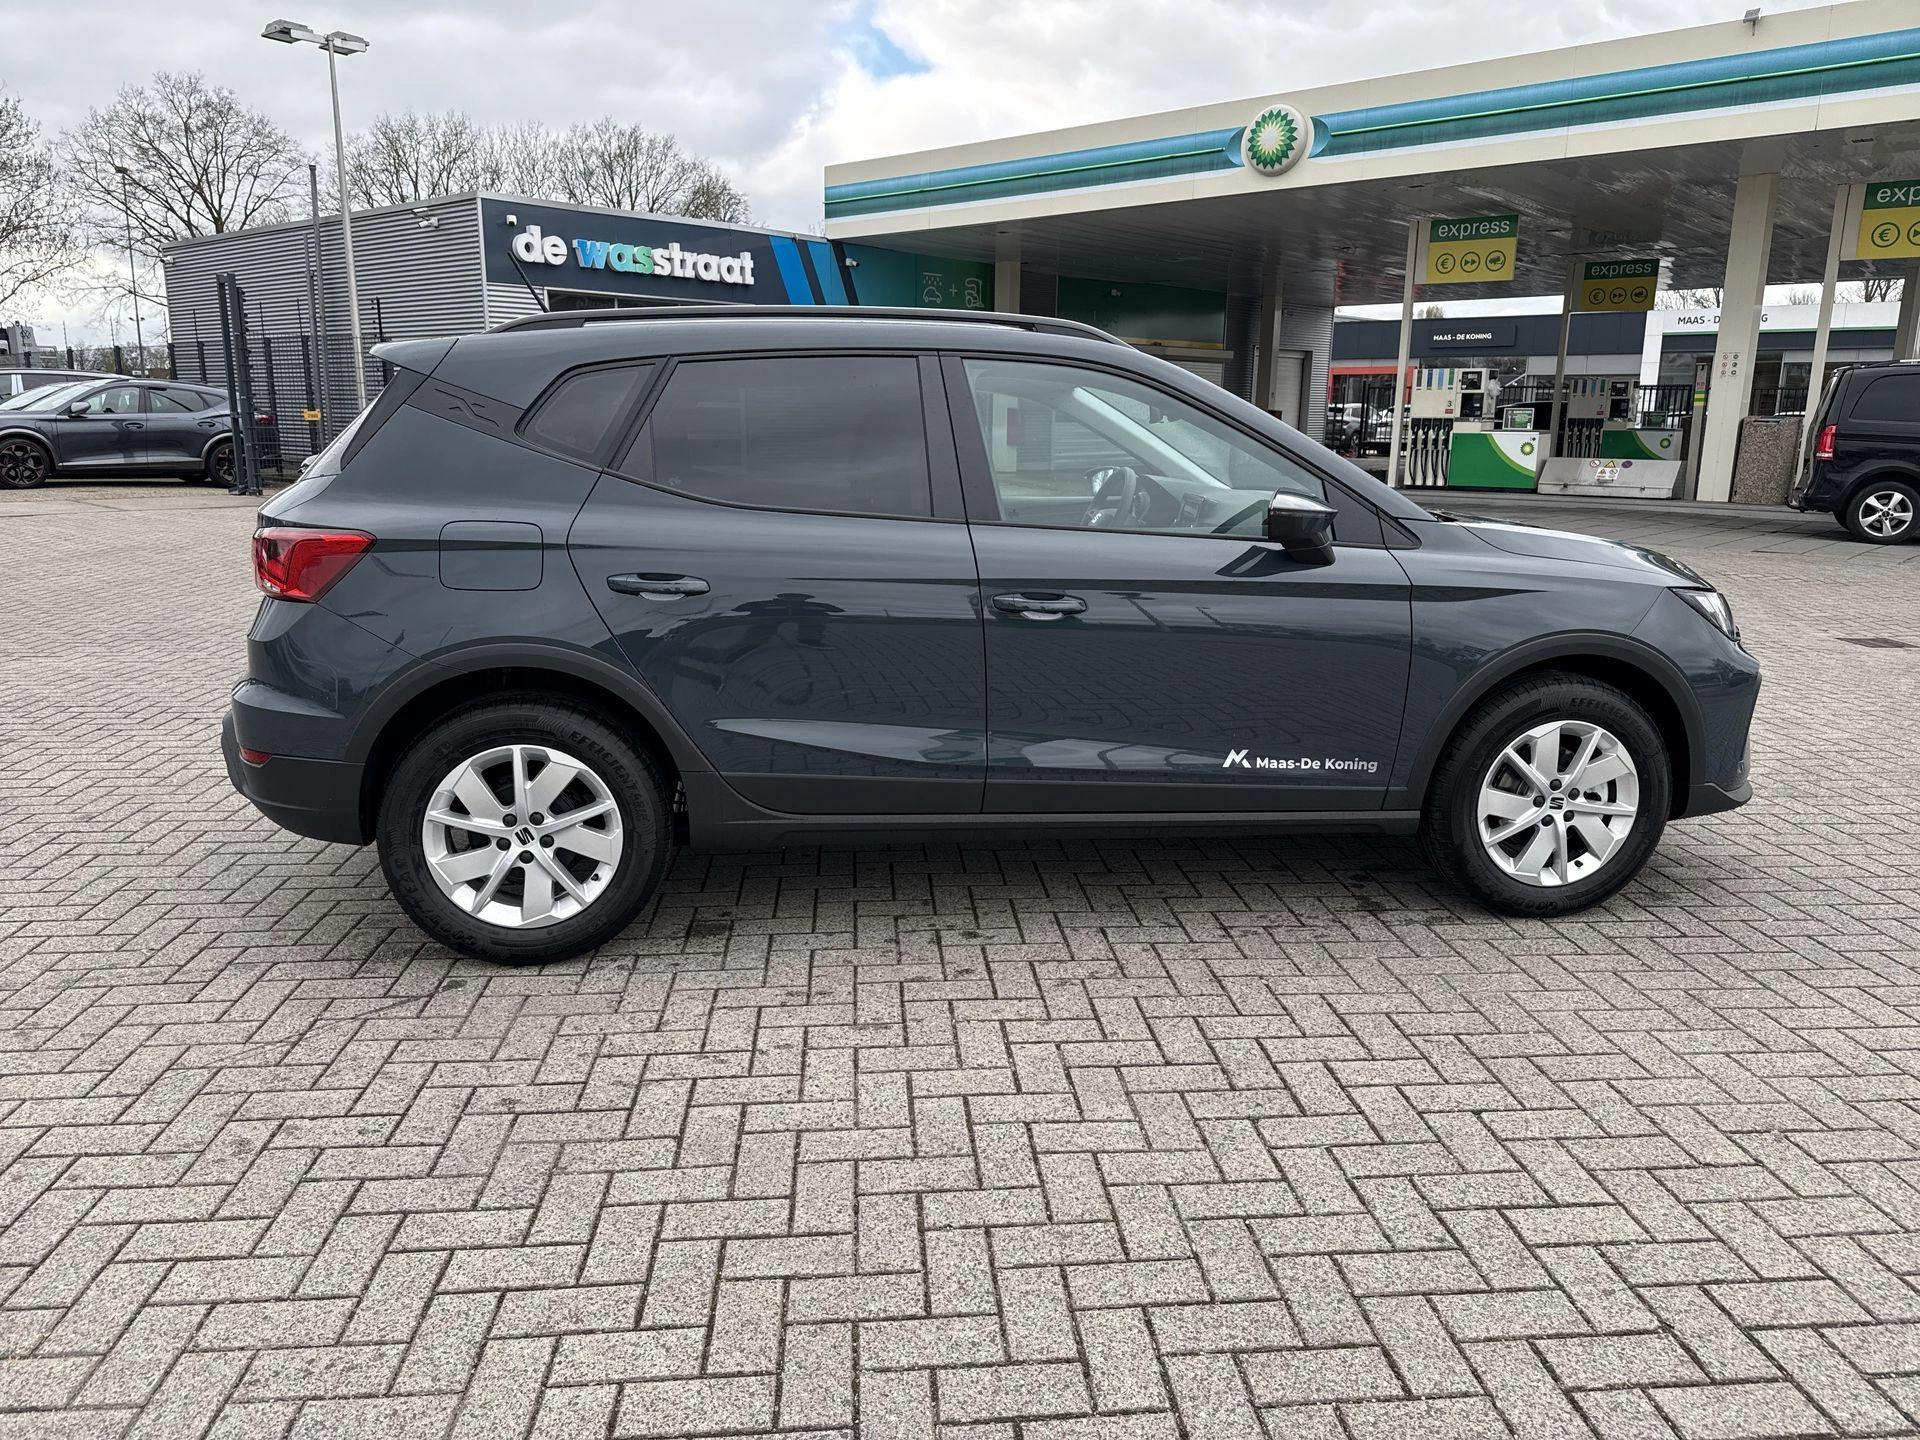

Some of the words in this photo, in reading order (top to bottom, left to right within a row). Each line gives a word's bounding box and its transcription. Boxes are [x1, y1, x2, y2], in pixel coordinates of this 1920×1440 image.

[1438, 220, 1511, 239] express
[512, 225, 568, 266] de
[572, 239, 755, 285] wasstraat
[1591, 263, 1652, 278] express
[1678, 315, 1705, 325] MAAS
[1256, 757, 1321, 770] Maas-De
[1325, 758, 1378, 773] Koning
